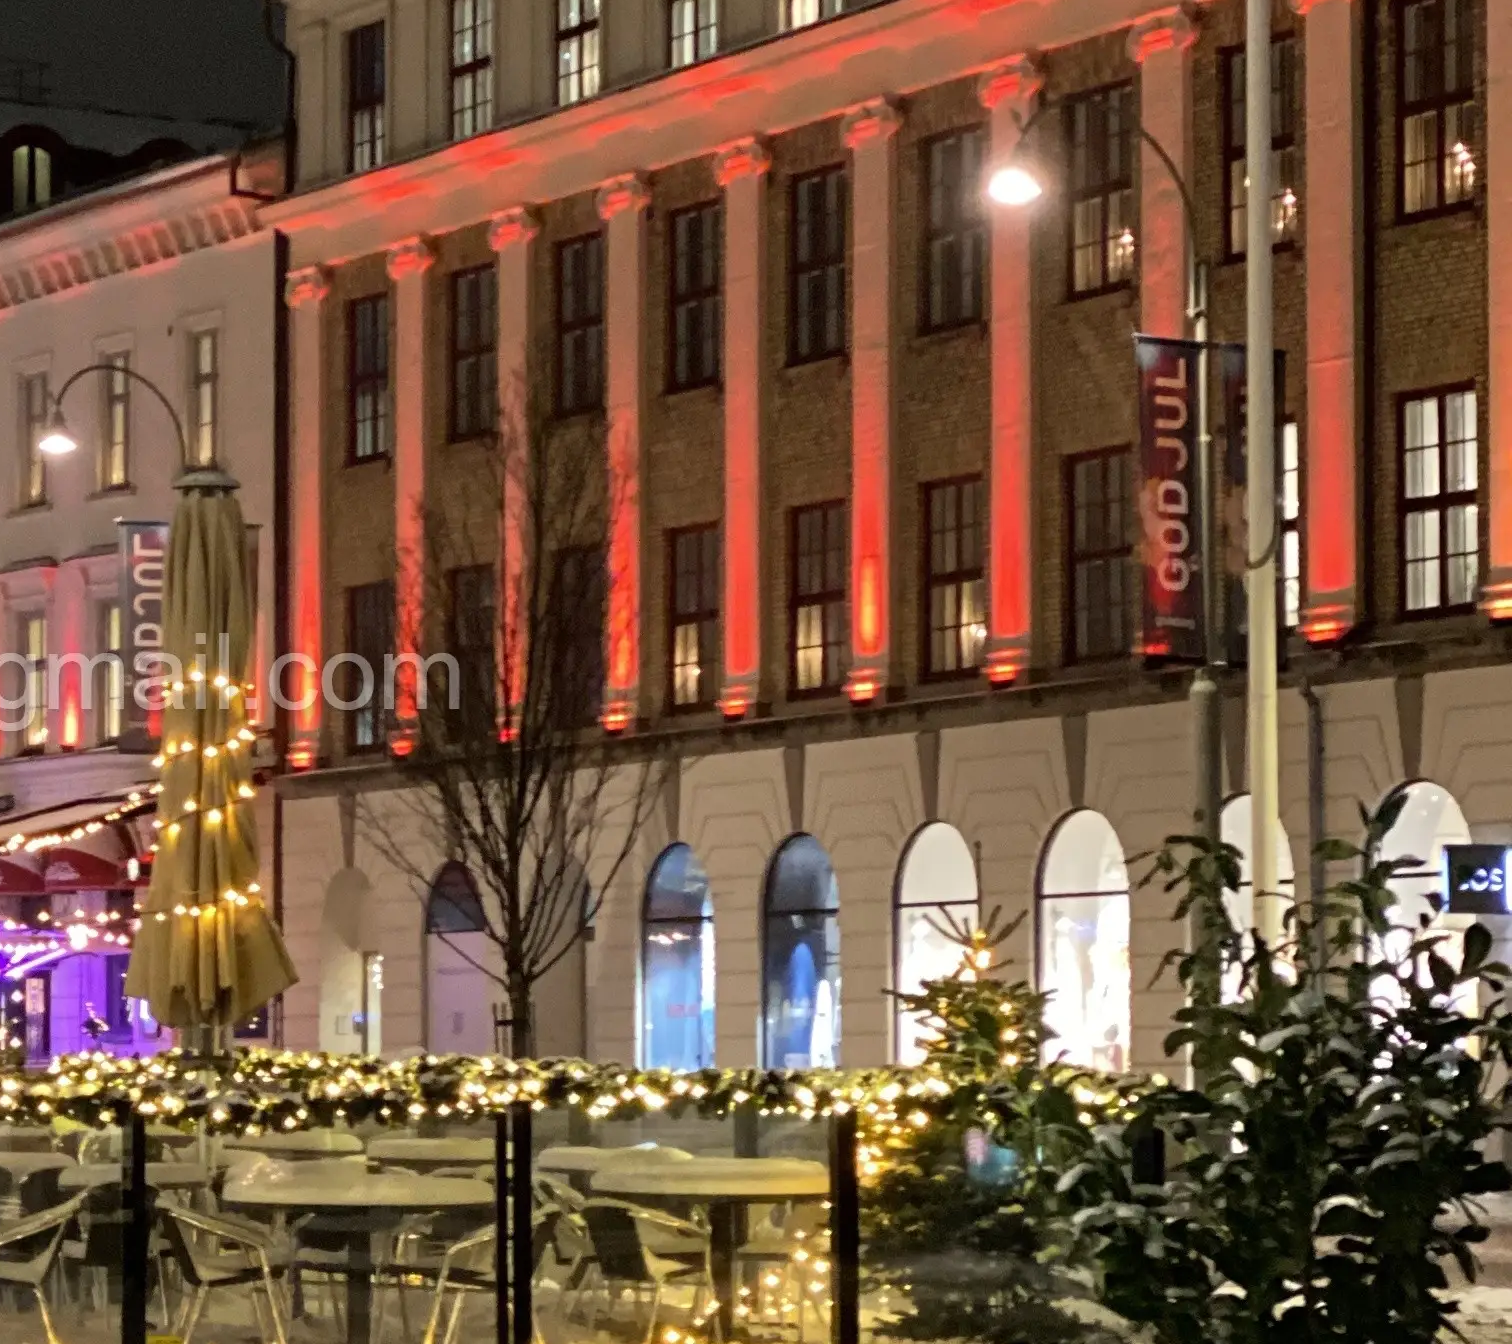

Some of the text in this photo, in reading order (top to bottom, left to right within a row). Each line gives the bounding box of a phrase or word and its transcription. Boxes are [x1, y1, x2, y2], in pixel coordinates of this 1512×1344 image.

[1154, 358, 1187, 471] JUL
[133, 533, 165, 616] JUL
[1157, 479, 1190, 592] GOD
